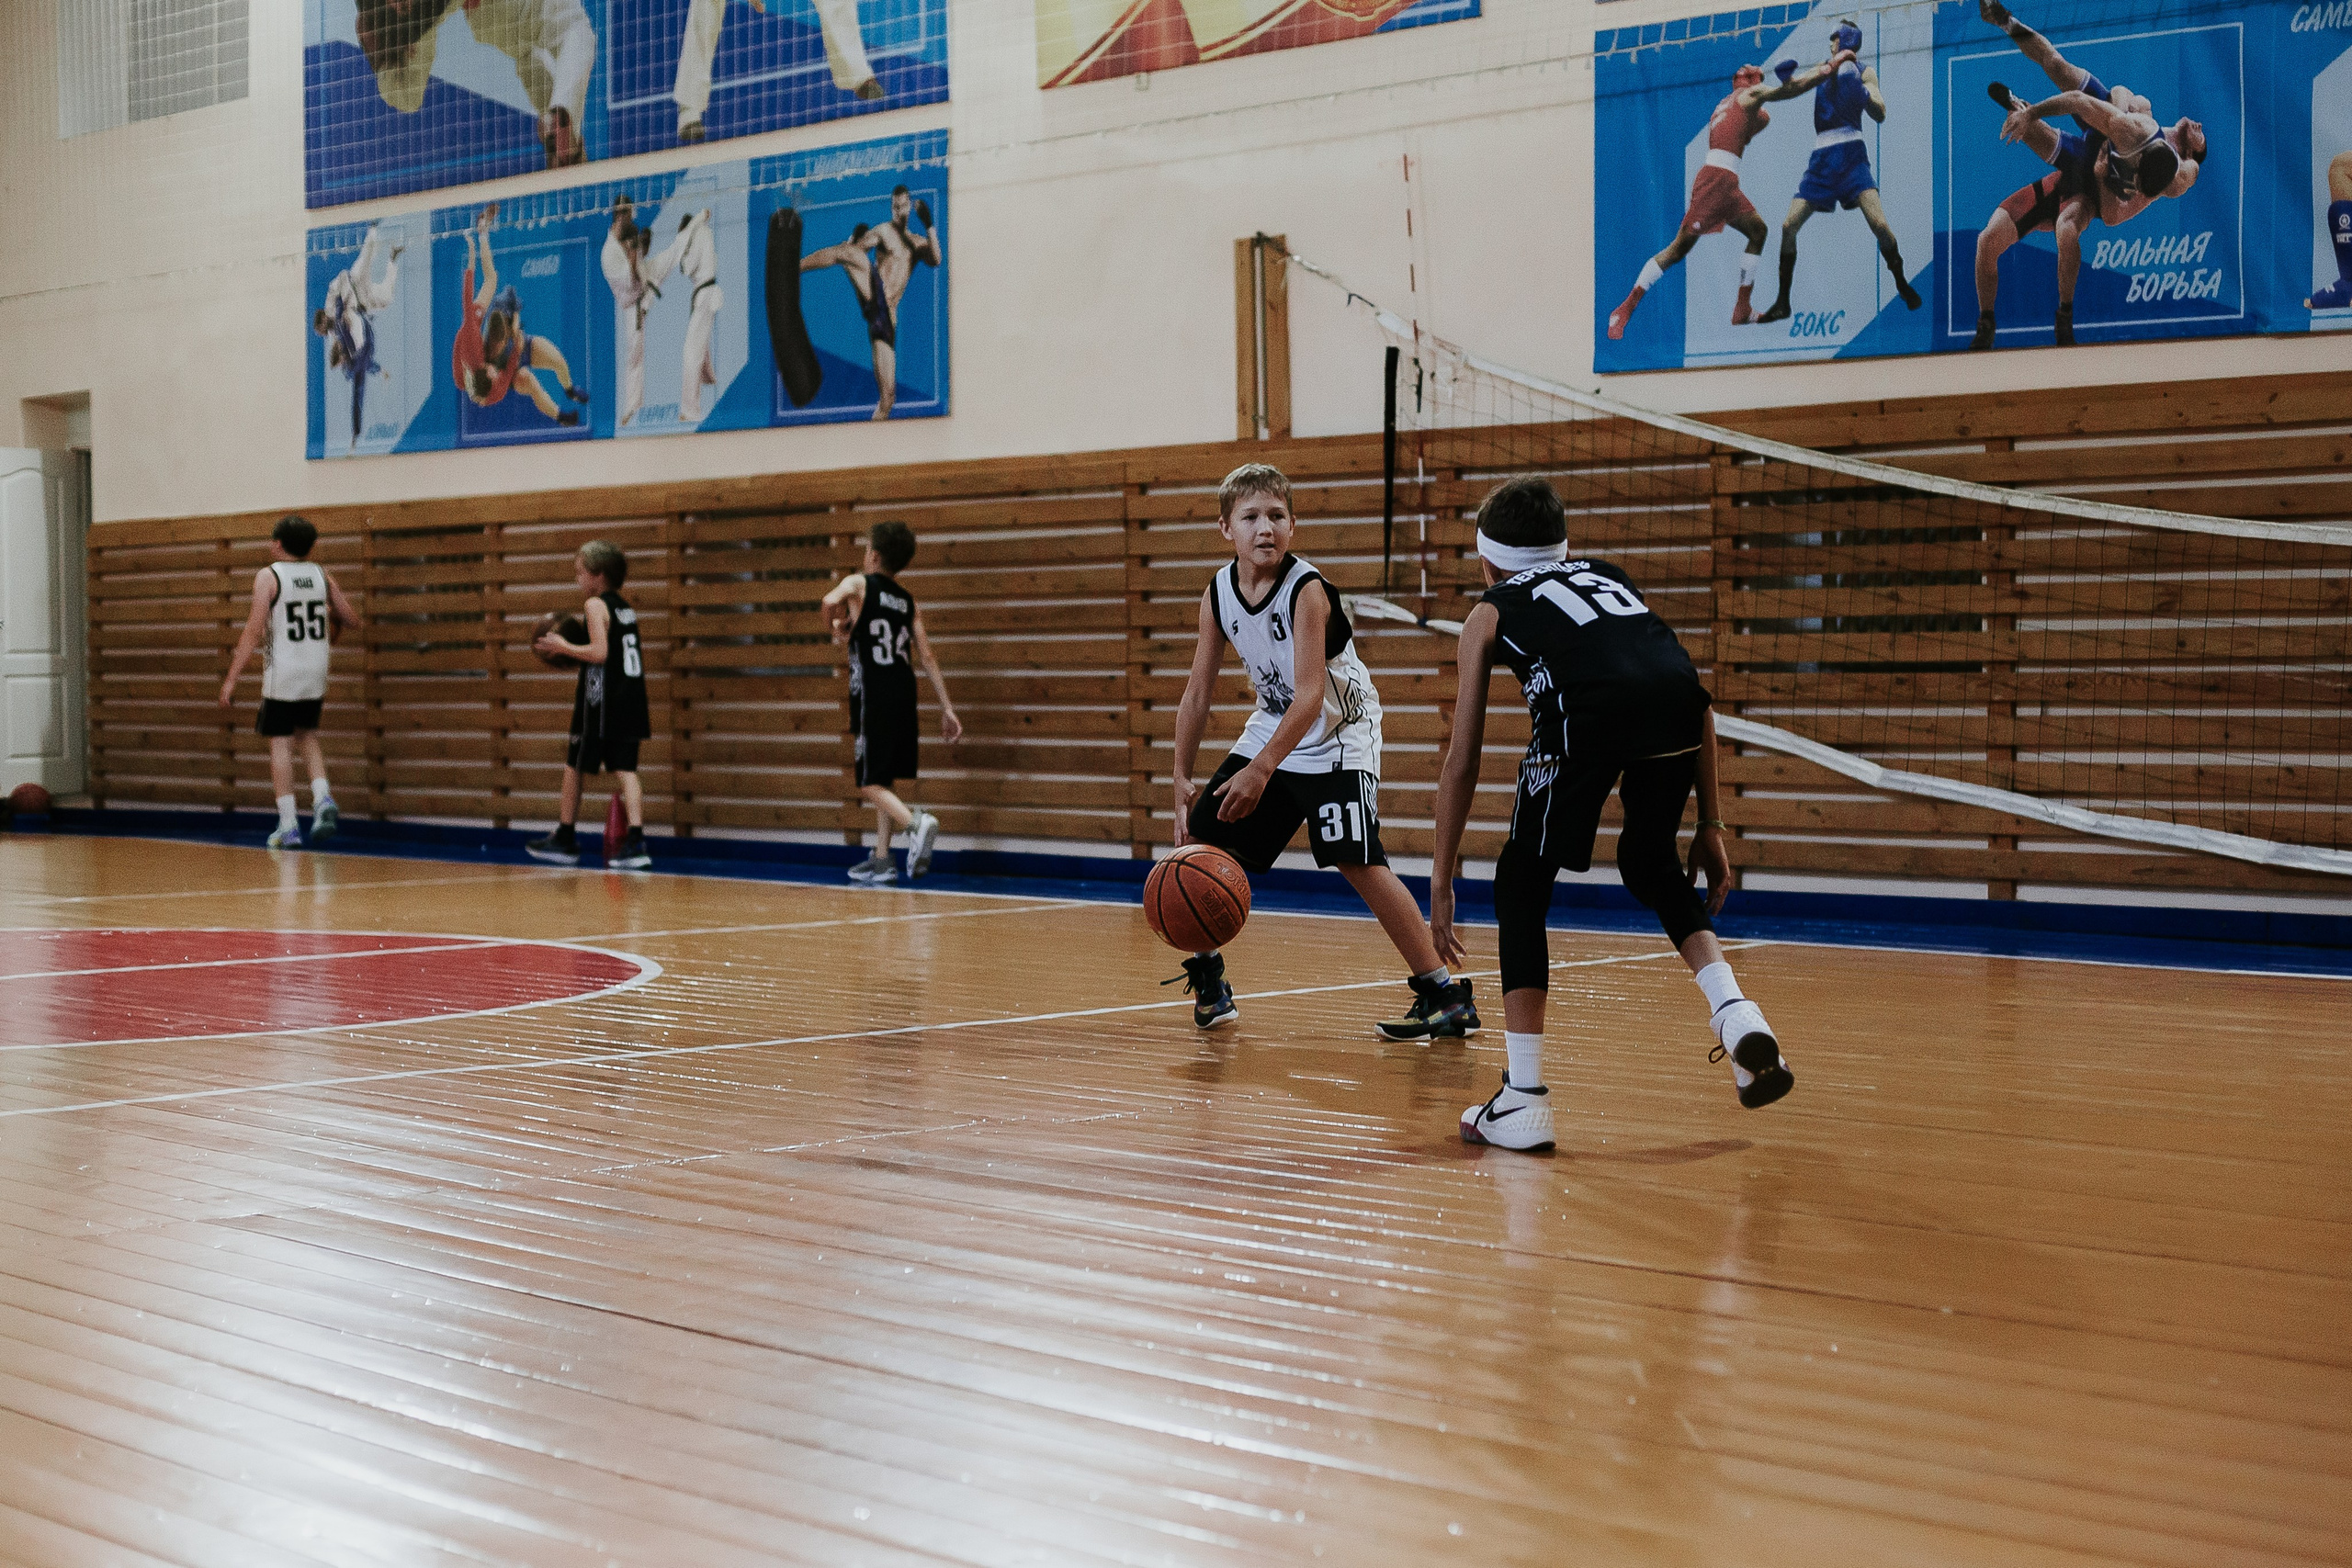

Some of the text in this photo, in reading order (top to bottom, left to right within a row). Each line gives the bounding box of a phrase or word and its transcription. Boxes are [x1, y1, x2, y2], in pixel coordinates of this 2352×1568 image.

[2091, 231, 2212, 270] ВОЛЬНАЯ
[2126, 268, 2222, 303] БОРЬБА
[1789, 310, 1846, 338] БОКС
[1532, 571, 1649, 626] 13
[285, 600, 325, 642] 55
[1272, 611, 1287, 641] 3
[622, 633, 641, 677] 6
[1318, 801, 1362, 842] 31
